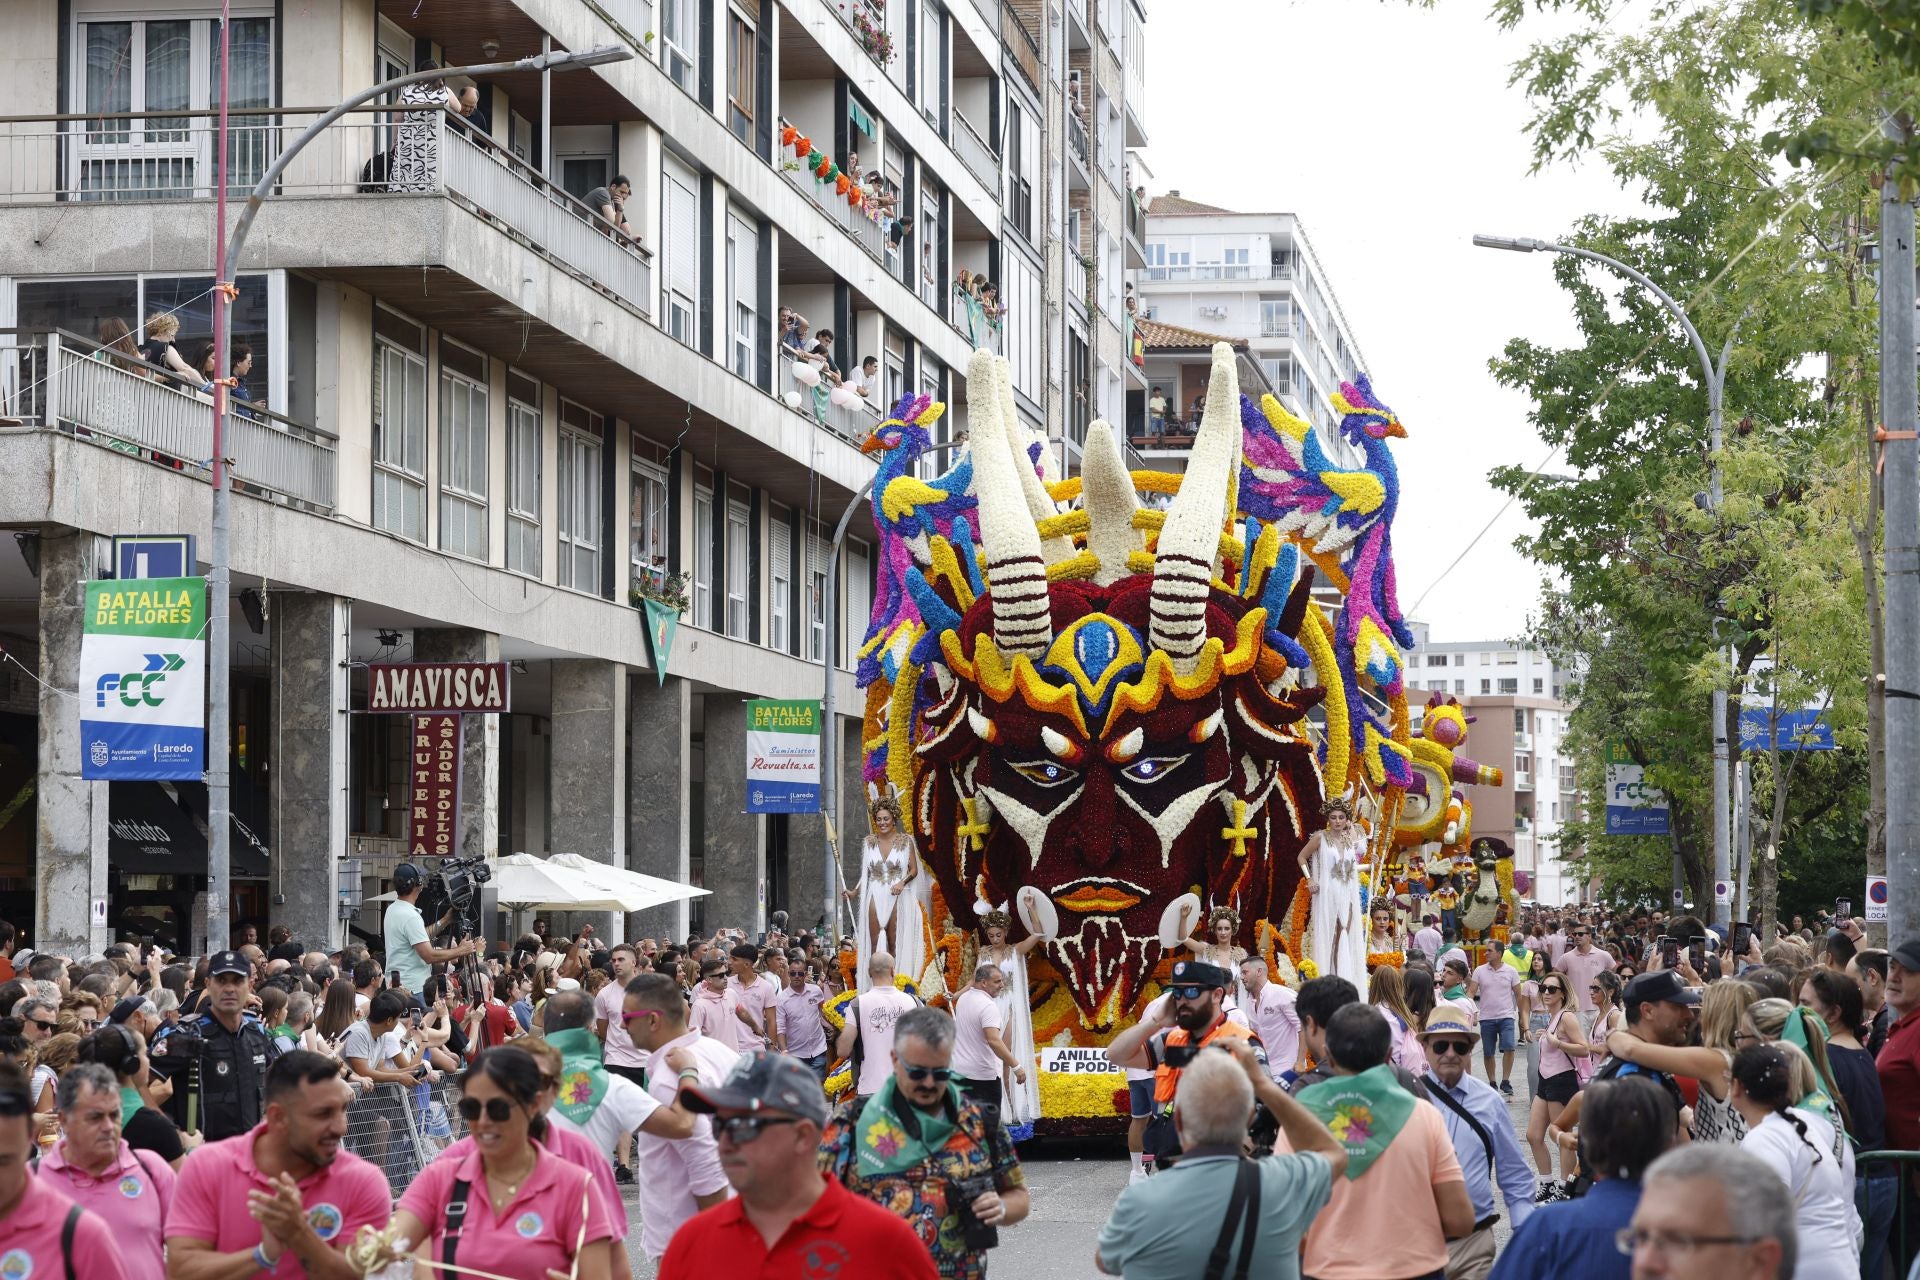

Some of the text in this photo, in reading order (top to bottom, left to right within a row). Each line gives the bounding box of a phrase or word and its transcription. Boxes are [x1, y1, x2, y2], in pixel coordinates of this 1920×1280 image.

[98, 590, 192, 610] BATALLA
[96, 608, 192, 625] DE FLORES
[96, 673, 165, 708] FCC
[372, 668, 501, 708] AMAVISCA
[755, 706, 813, 718] BATALLA
[755, 717, 813, 727] DE FLORES
[157, 743, 193, 753] Laredo
[769, 746, 816, 755] Suministros
[412, 717, 432, 855] FRUTERIA
[435, 717, 455, 855] ASADOR POLLOS
[1049, 1061, 1119, 1073] DE PODE
